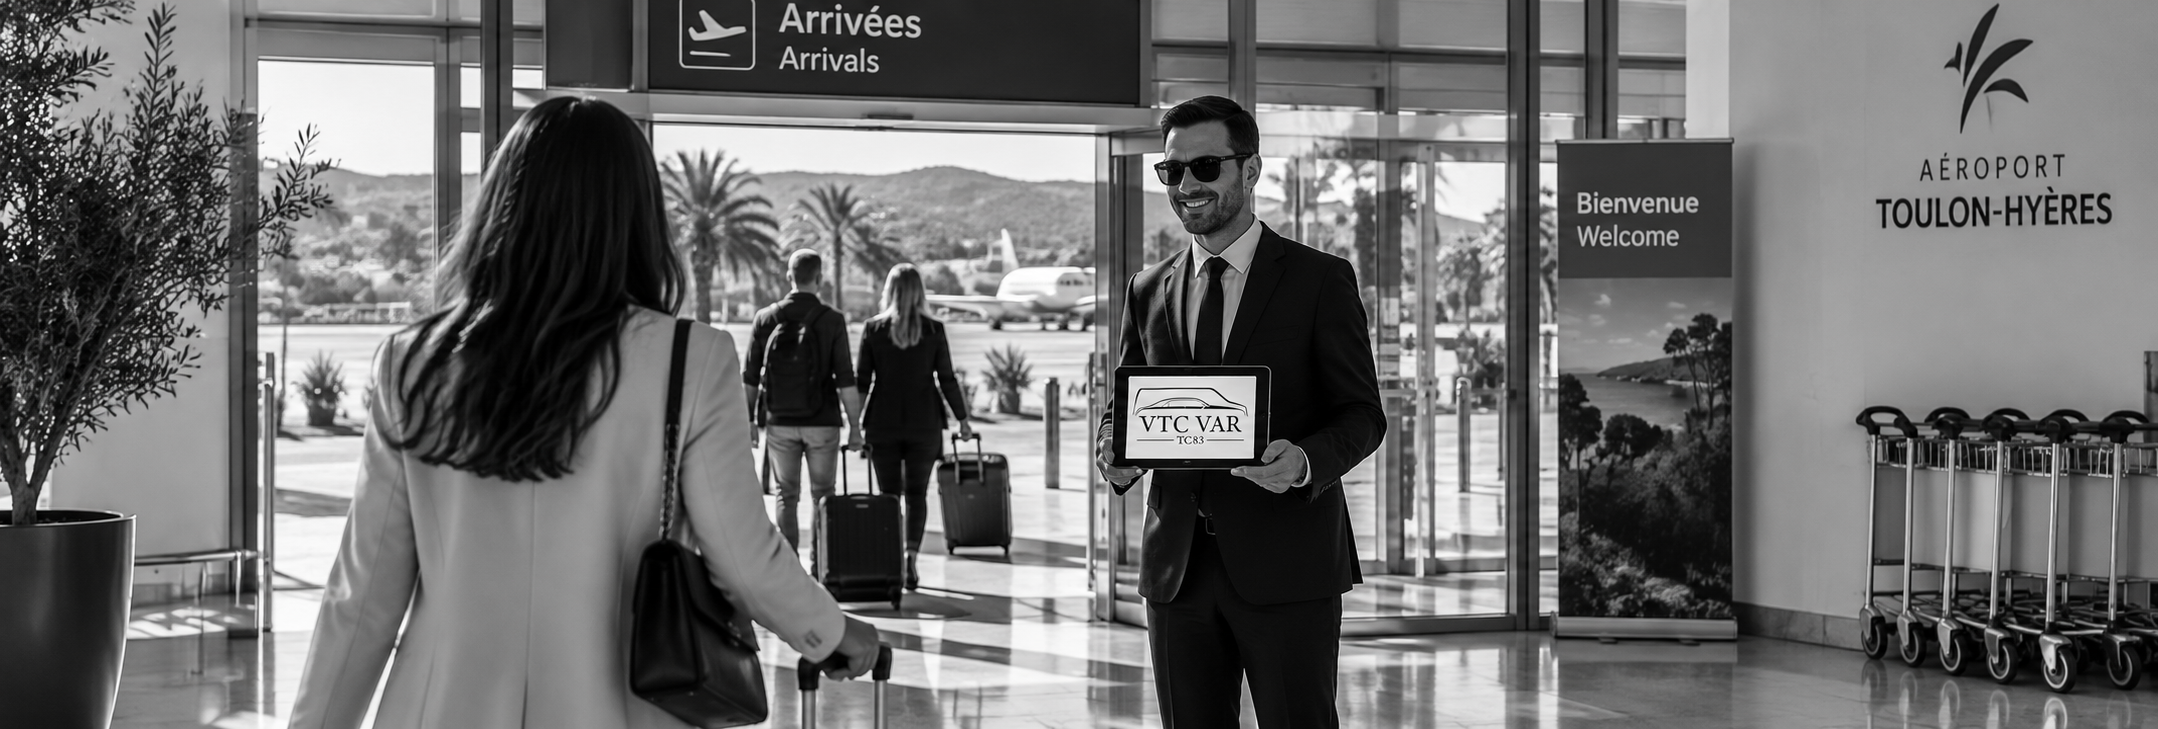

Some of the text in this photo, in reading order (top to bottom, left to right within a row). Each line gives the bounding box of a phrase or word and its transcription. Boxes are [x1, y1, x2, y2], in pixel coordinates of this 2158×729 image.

[778, 2, 922, 39] Arrivées
[778, 45, 880, 74] Arrivals
[1919, 152, 2066, 182] AÉROPORT
[1576, 191, 1699, 215] Bienvenue
[1875, 186, 2113, 229] TOULON-HYÈRES
[1576, 223, 1680, 247] Welcome
[1139, 415, 1242, 433] VTC VAR
[1176, 435, 1205, 445] TC83
